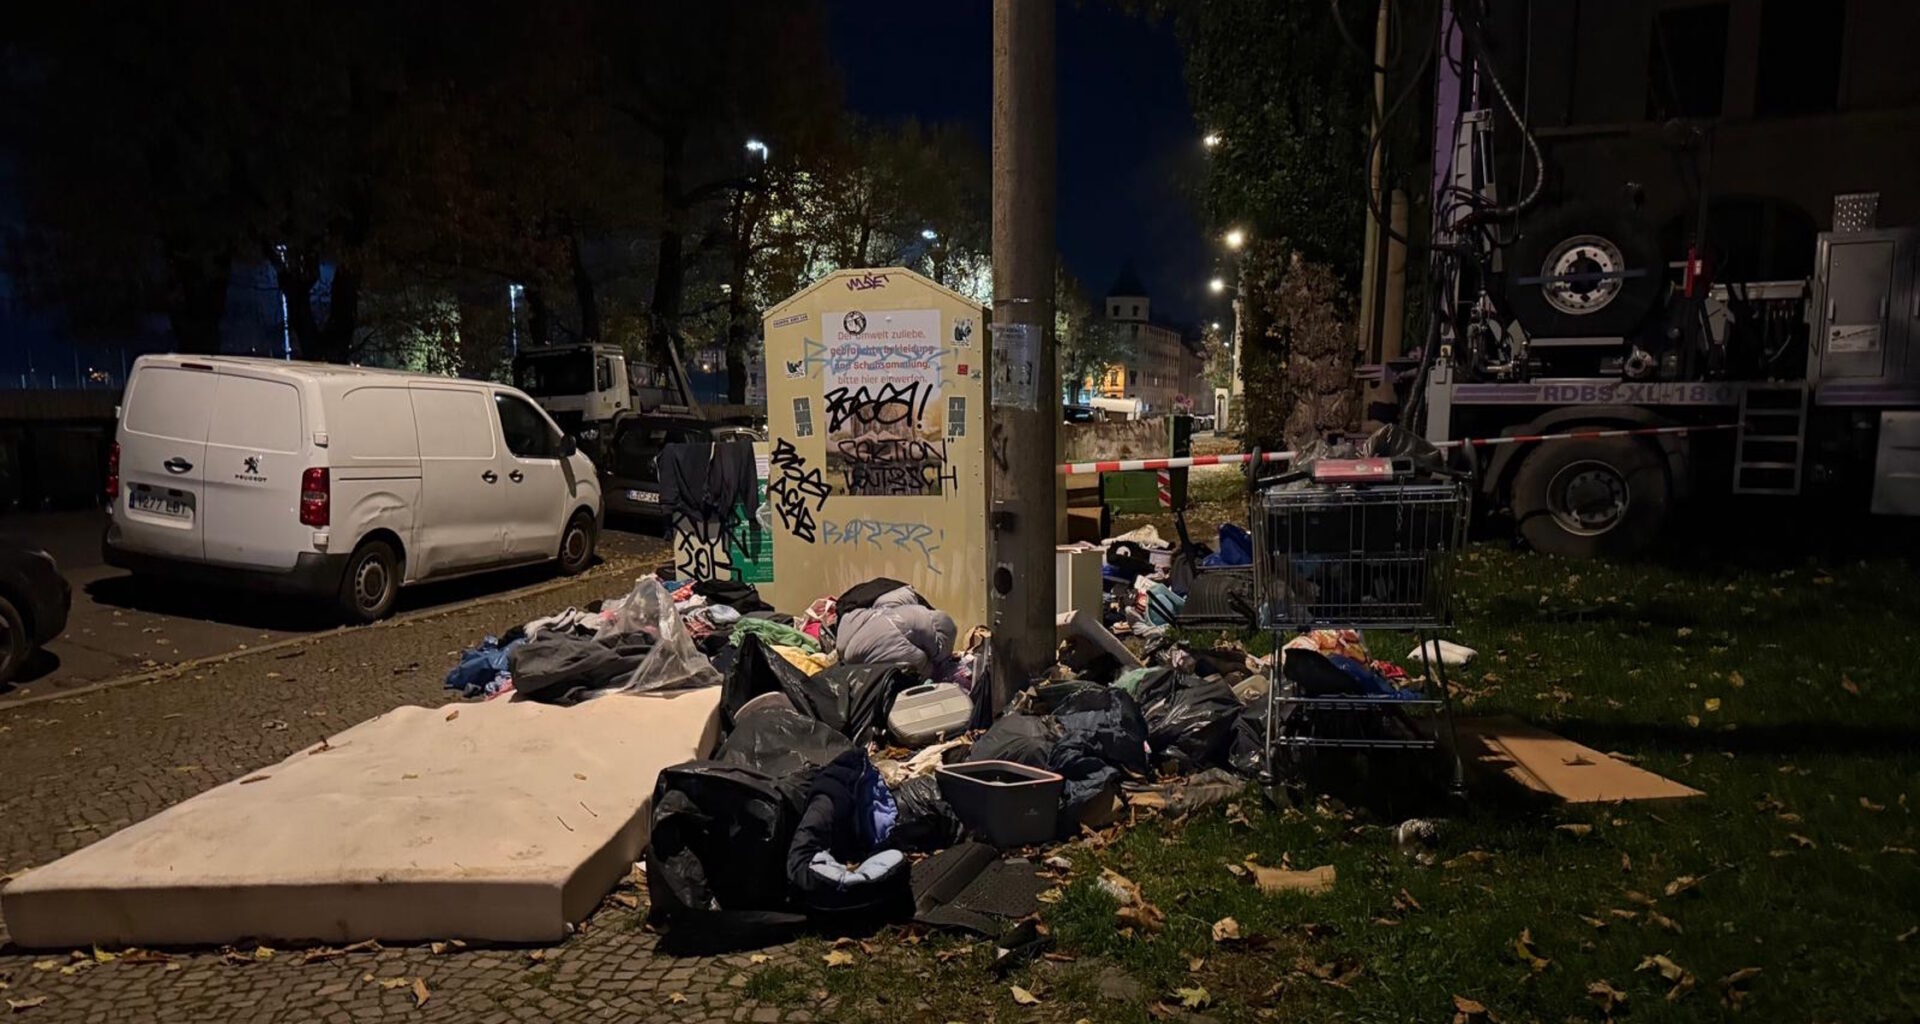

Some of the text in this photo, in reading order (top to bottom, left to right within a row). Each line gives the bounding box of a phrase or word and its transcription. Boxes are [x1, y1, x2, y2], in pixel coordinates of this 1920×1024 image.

[838, 375, 859, 384] bitte
[861, 374, 878, 383] hier
[234, 474, 268, 482] PEUGEOT
